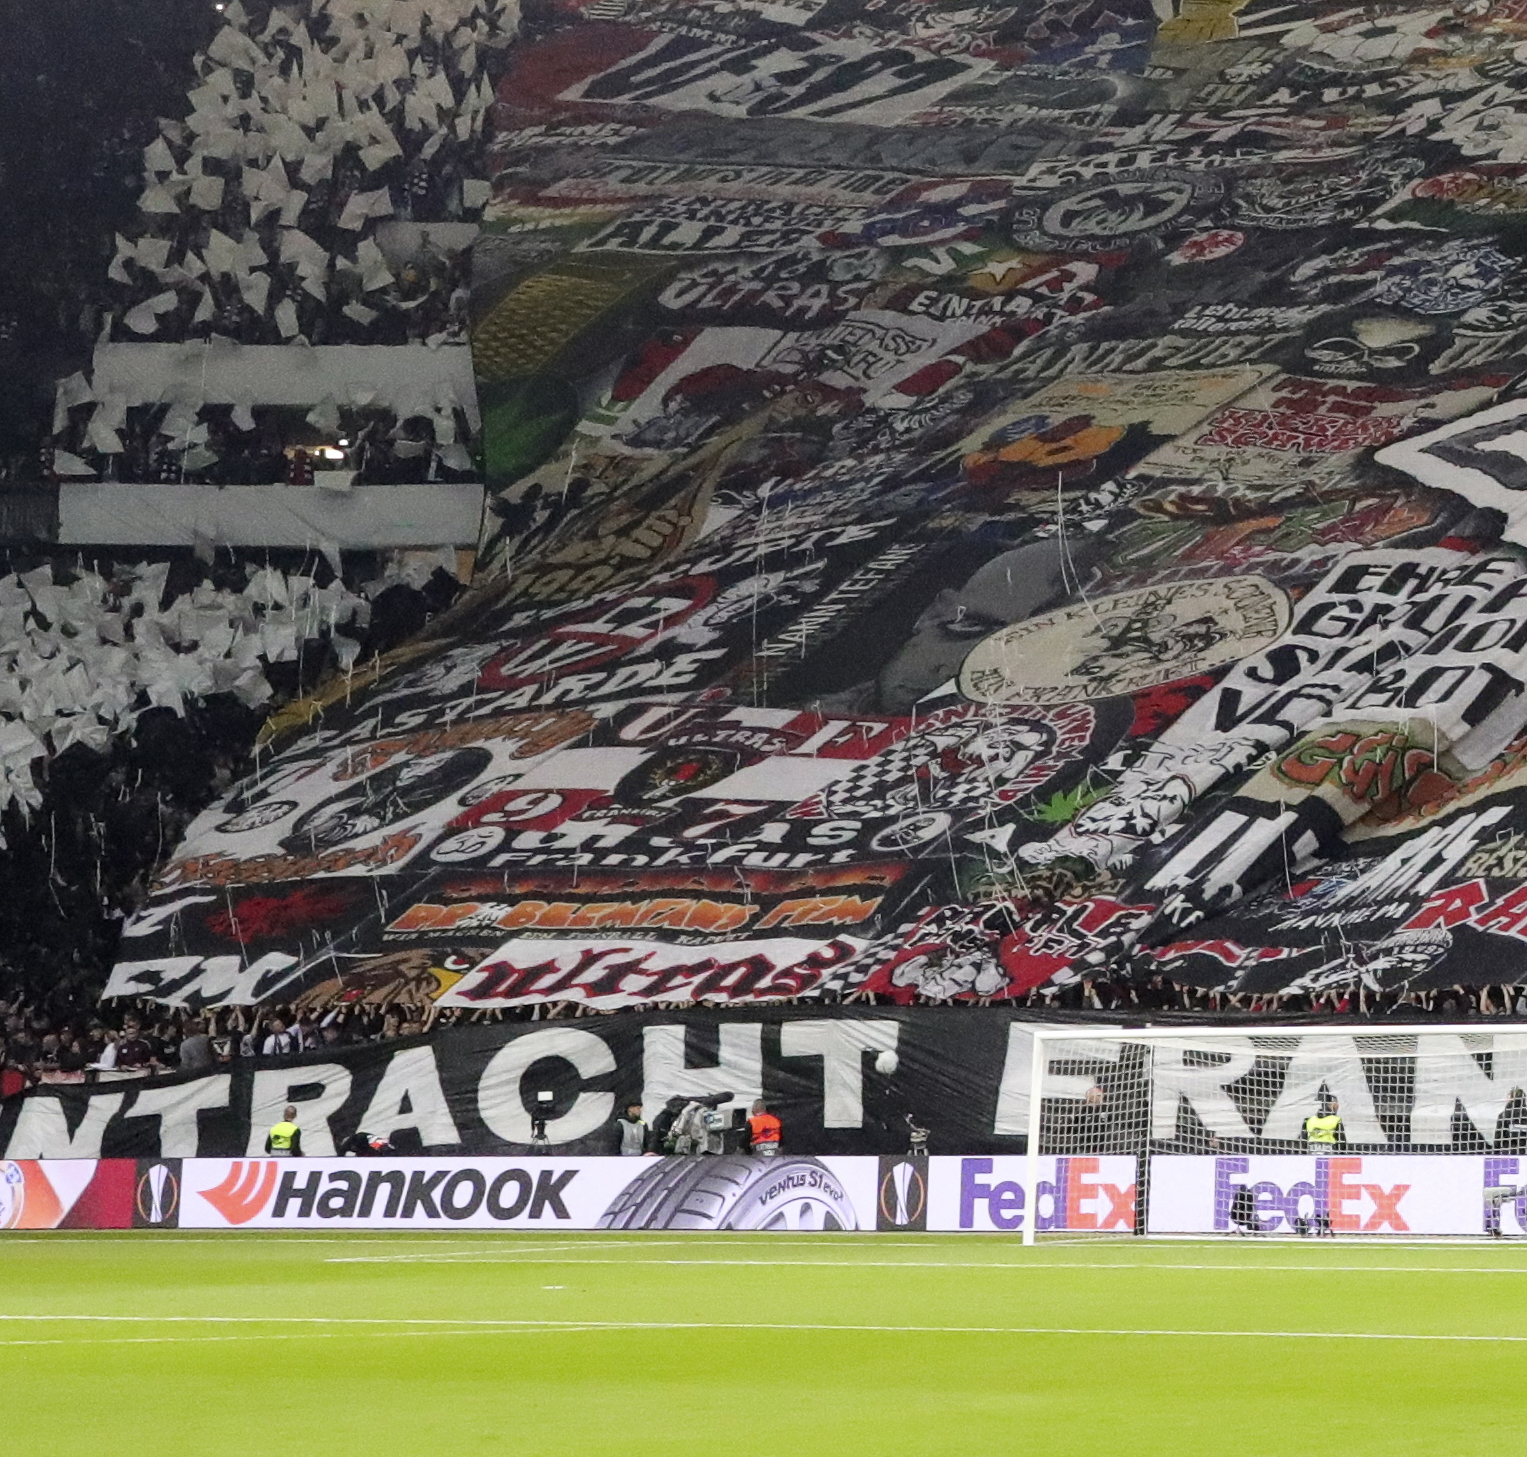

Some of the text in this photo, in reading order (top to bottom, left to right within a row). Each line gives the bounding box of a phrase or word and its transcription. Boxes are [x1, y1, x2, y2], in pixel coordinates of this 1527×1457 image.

[487, 845, 858, 870] Frankfurt
[960, 1157, 1136, 1230] FedEx
[1213, 1157, 1411, 1232] FedEx
